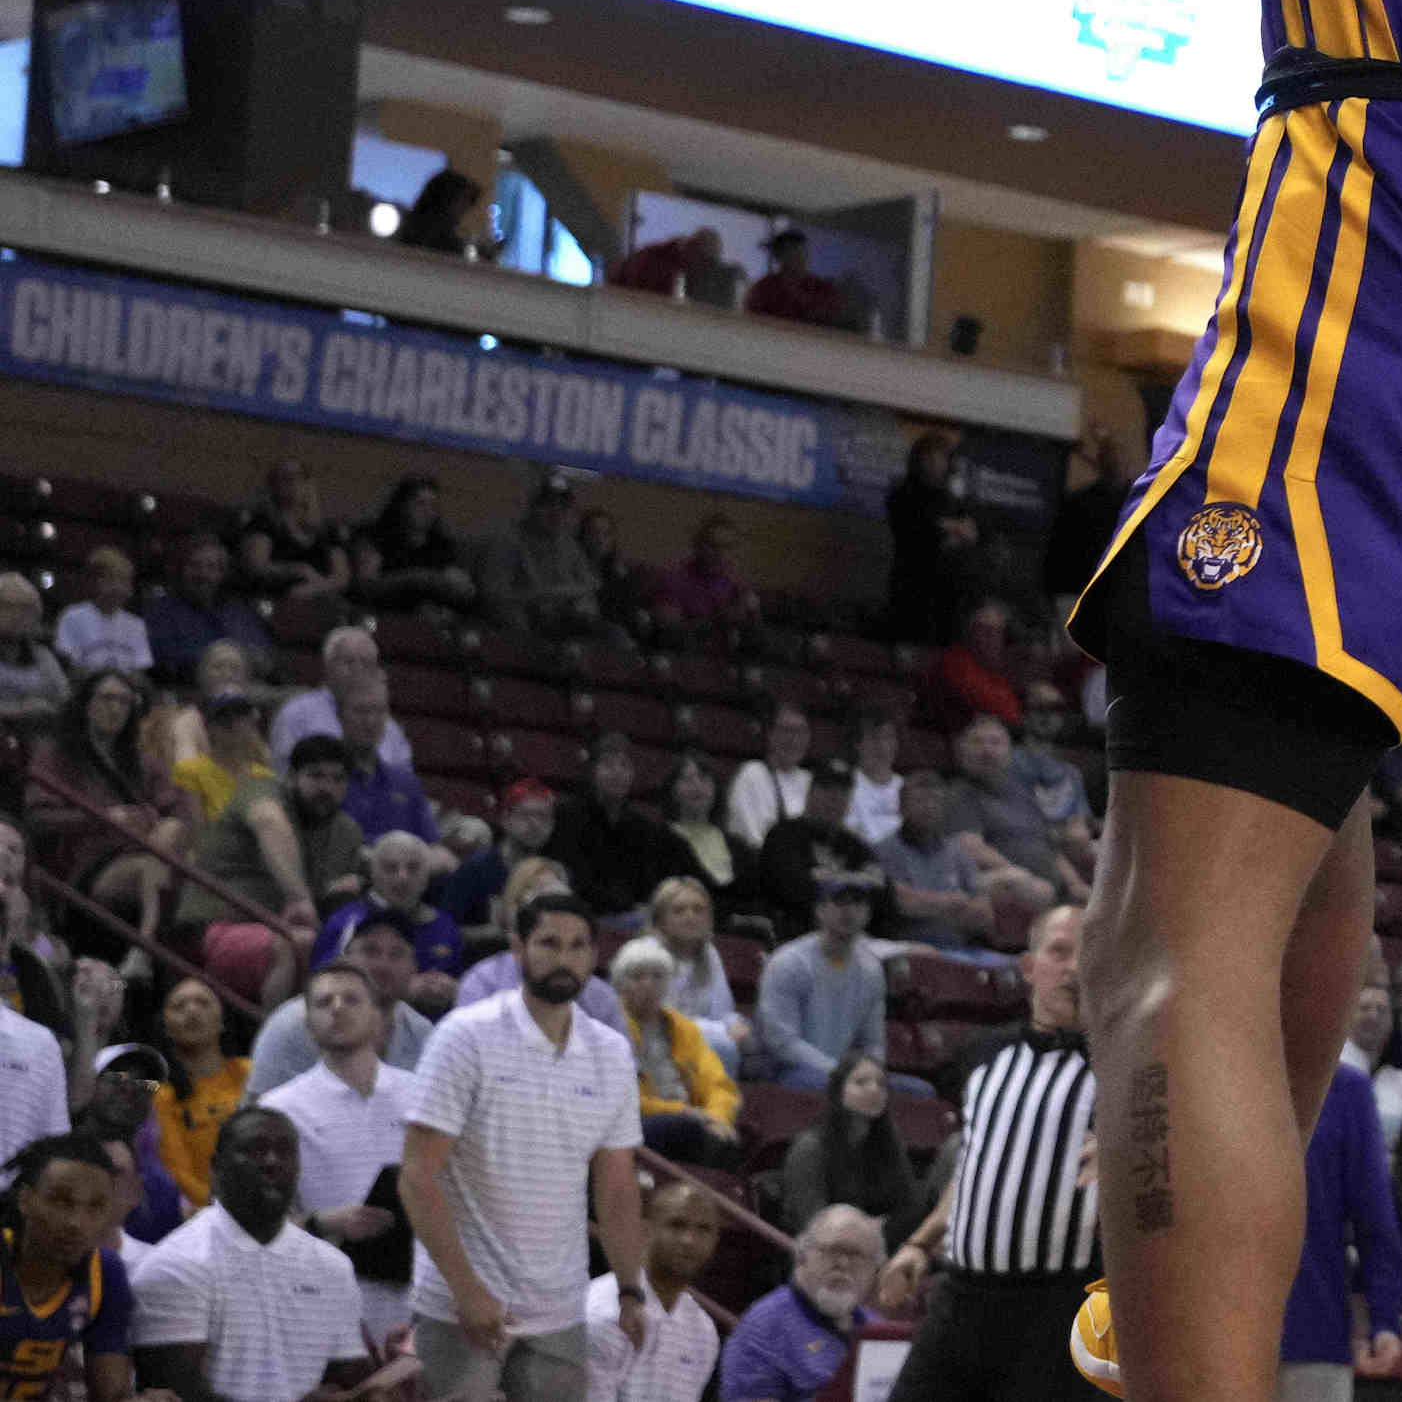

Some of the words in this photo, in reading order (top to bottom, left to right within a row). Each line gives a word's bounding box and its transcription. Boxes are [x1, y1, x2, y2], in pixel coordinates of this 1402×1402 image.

[11, 276, 313, 402] CHILDREN'S
[320, 330, 624, 460] CHARLESTON
[631, 380, 818, 490] CLASSIC
